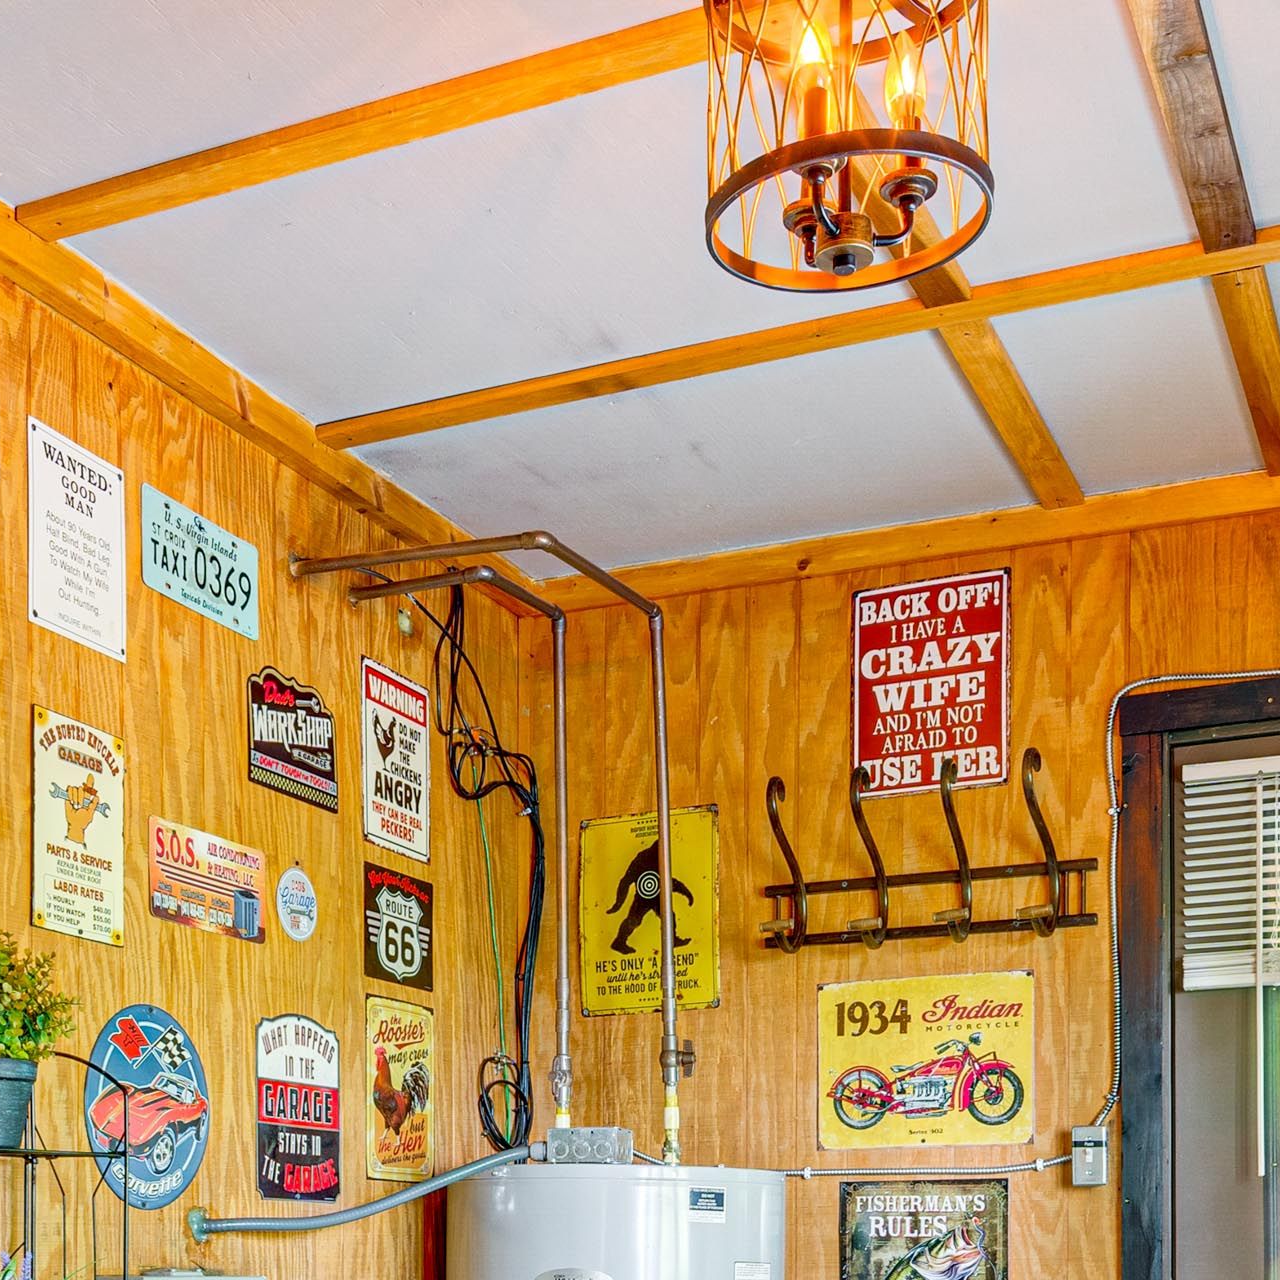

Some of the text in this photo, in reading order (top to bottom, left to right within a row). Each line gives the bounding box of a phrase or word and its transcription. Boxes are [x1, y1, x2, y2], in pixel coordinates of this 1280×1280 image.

[42, 440, 113, 496] WANTED:
[61, 474, 97, 505] GOOD
[64, 492, 94, 519] MAN
[165, 529, 186, 550] CROIX
[187, 523, 209, 546] Virgin
[212, 537, 237, 562] Islands
[151, 538, 252, 611] TAXI 0369
[860, 580, 1001, 626] BACK OFF!
[891, 616, 965, 643] I HAVE A
[861, 631, 1001, 680] CRAZY
[263, 681, 295, 706] Dad's
[368, 673, 425, 719] WARNING
[872, 670, 986, 713] WIFE
[252, 703, 332, 753] WORKSHOP
[399, 722, 421, 743] DO NOT
[872, 703, 986, 735] AND I'M NOT
[56, 724, 86, 748] BUSTED
[87, 731, 120, 777] KNUCKLE
[399, 736, 416, 755] MAKE
[882, 726, 978, 754] AFRAID TO
[58, 745, 103, 775] GARAGE
[258, 756, 279, 770] DON'T
[281, 764, 301, 779] TOUCH
[302, 752, 328, 768] GARAGE
[399, 750, 411, 766] THE
[861, 745, 1001, 790] USE HER
[390, 763, 422, 787] CHICKENS
[374, 771, 422, 814] ANGRY
[372, 801, 423, 832] THEY CAN BE REAL
[381, 817, 415, 844] PECKERS!
[47, 843, 112, 872] PARTS & SERVICE
[156, 827, 200, 870] S.O.S.
[207, 842, 218, 857] AIR
[54, 880, 104, 902] LABOR RATES
[53, 904, 64, 913] YOU
[66, 908, 85, 918] WATCH
[53, 914, 64, 923] YOU
[385, 898, 414, 919] ROUTE
[385, 920, 414, 967] 66
[596, 957, 657, 973] HE'S ONLY "A
[607, 971, 647, 983] until he's
[597, 982, 657, 996] TO THE HOOD OF
[390, 1014, 401, 1026] the
[835, 994, 1023, 1037] 1934 Indian
[925, 1021, 1020, 1033] MOTORCYCLE
[261, 1024, 336, 1064] WHAT HAPPENS
[373, 1020, 425, 1045] Rooster
[285, 1055, 315, 1080] IN THE
[388, 1050, 407, 1069] may
[263, 1083, 333, 1123] GARAGE
[278, 1131, 321, 1156] STAYS IN
[393, 1131, 425, 1156] Hen
[262, 1155, 339, 1194] THE GARAGE
[855, 1194, 986, 1213] FISHERMAN'S
[869, 1215, 947, 1238] RULES
